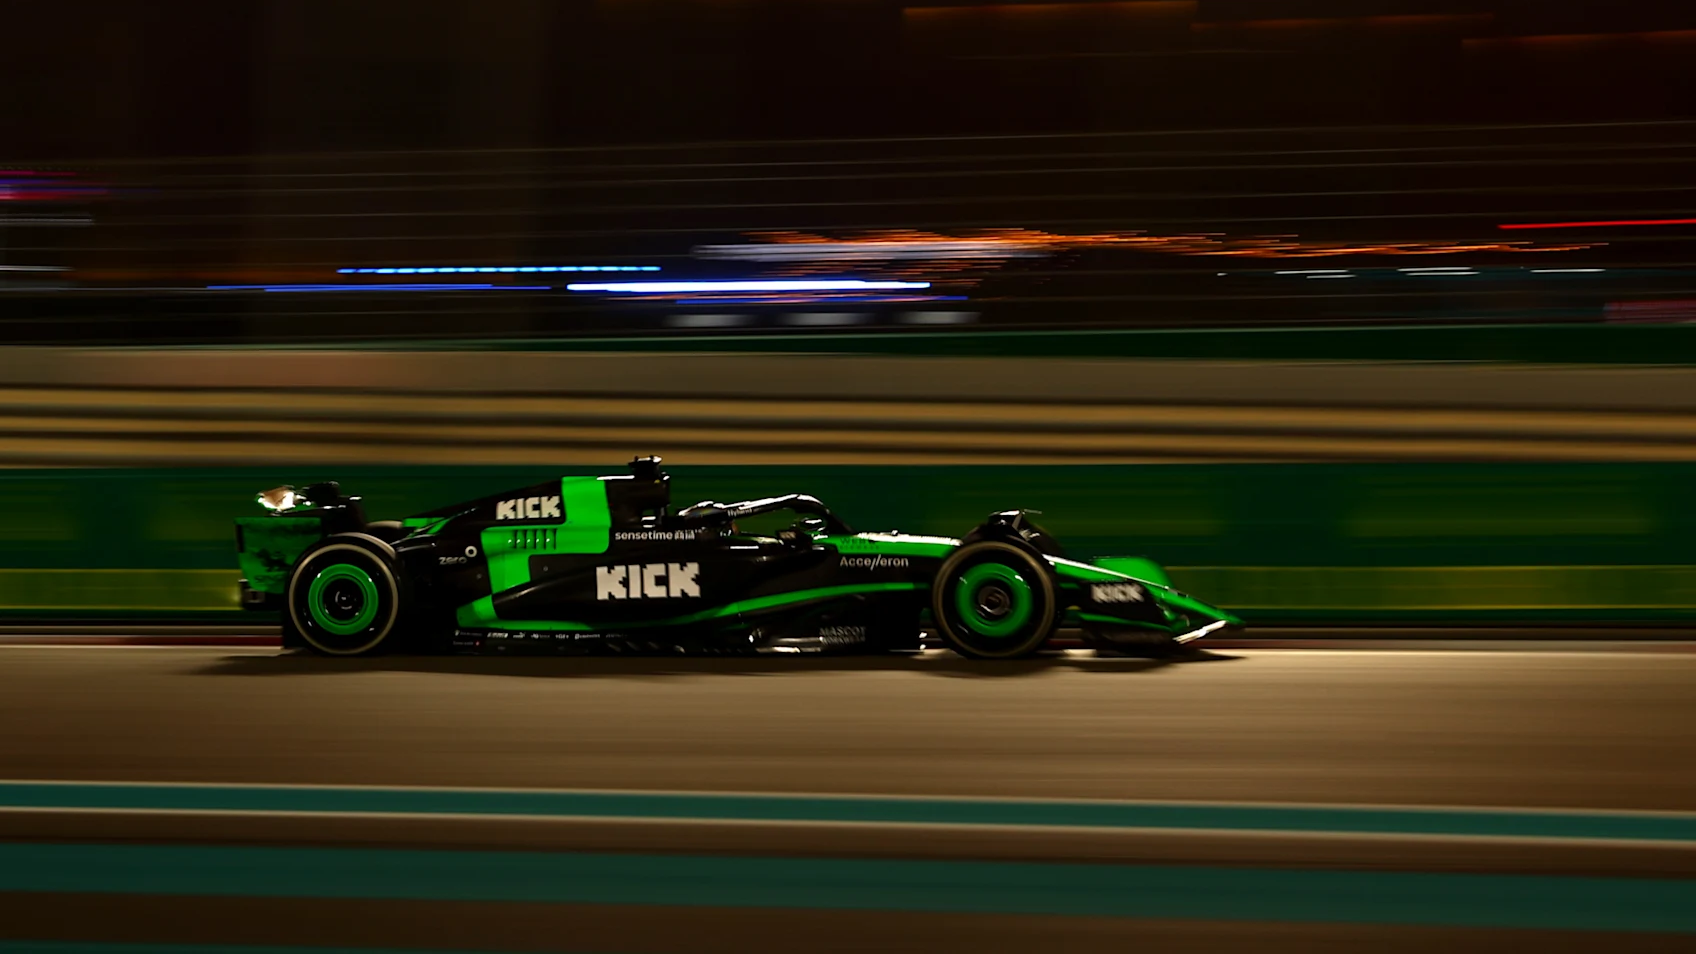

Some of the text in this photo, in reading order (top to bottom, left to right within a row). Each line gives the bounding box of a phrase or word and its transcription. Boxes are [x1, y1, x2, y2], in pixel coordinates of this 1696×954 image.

[495, 495, 561, 521] KICK
[615, 529, 673, 541] sensetime
[595, 561, 702, 601] KICK
[1090, 582, 1145, 604] KICK
